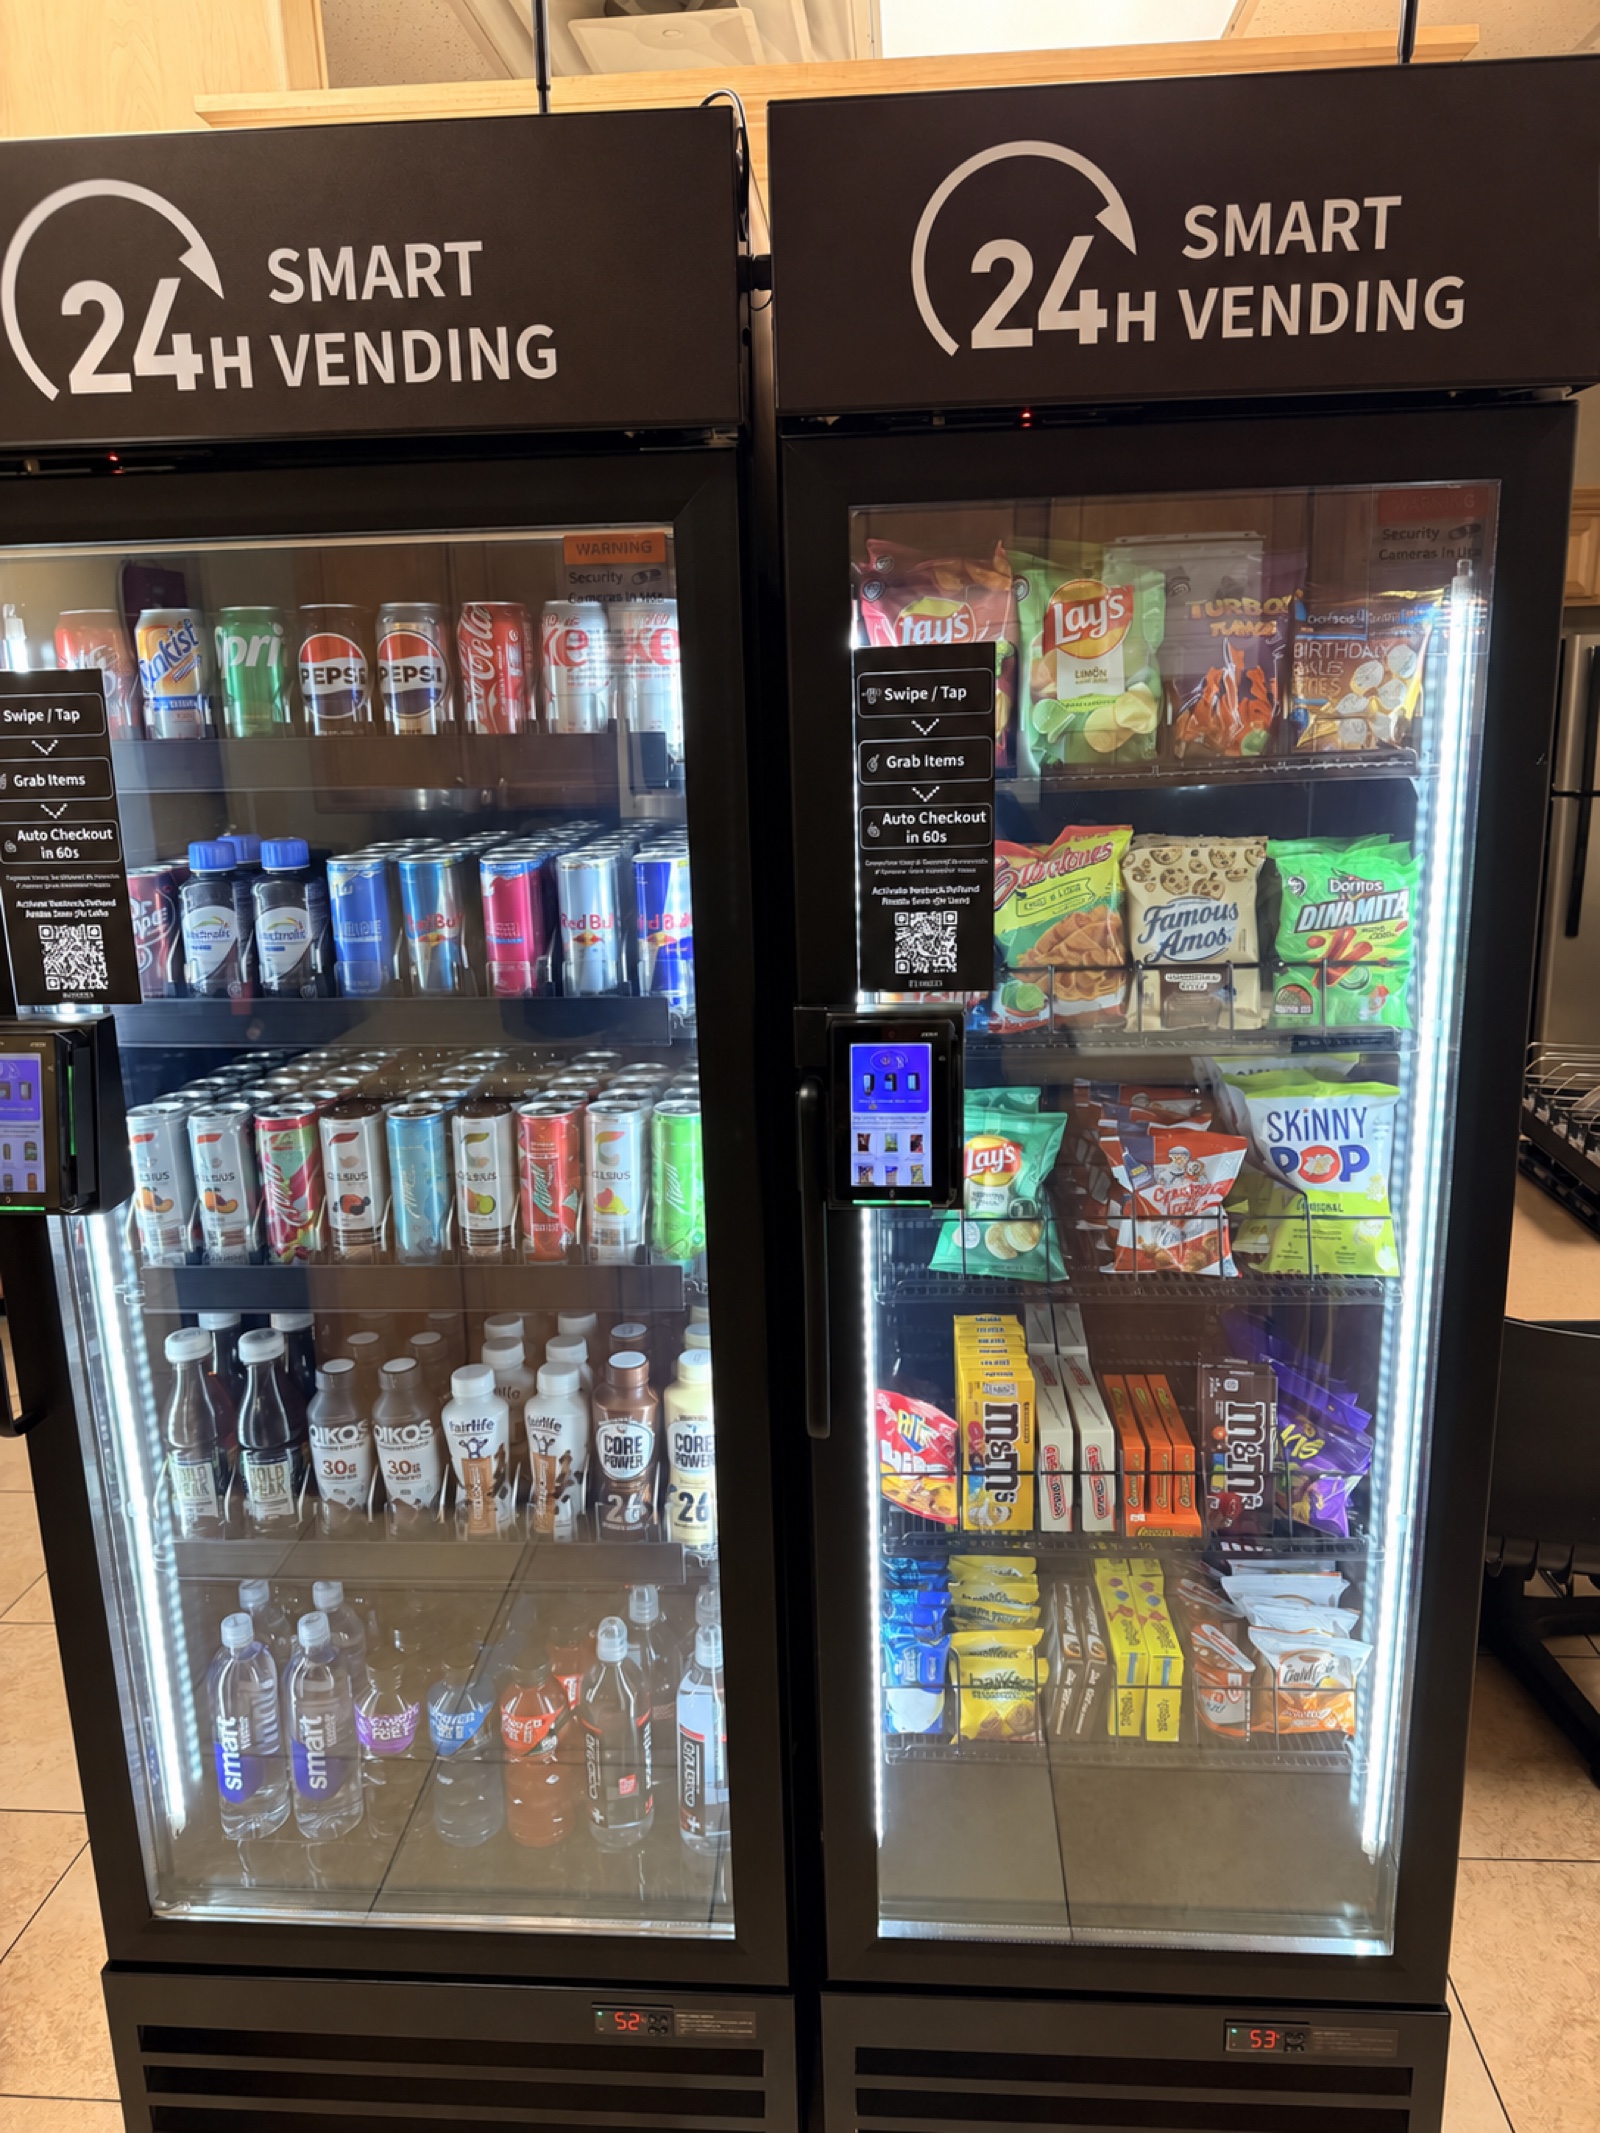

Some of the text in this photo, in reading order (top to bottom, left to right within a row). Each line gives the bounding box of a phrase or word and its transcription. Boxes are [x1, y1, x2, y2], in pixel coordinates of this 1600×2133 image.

[1182, 196, 1402, 260] SMART
[268, 241, 483, 303] SMART
[1179, 276, 1465, 340] VENDING
[270, 324, 558, 387] VENDING
[1383, 526, 1440, 542] Security
[575, 540, 653, 556] WARNING
[1379, 548, 1438, 561] Cameras
[568, 569, 623, 586] Security
[1053, 593, 1125, 646] Lay's
[301, 667, 368, 686] PEPSI
[379, 665, 443, 684] PEPSI
[884, 686, 929, 704] Swipe
[940, 686, 968, 701] Tap
[3, 708, 45, 725] Swipe
[54, 708, 81, 724] Tap
[886, 754, 965, 768] Grab Items
[13, 773, 86, 787] Grab Items
[882, 810, 987, 825] Auto Checkout
[17, 827, 114, 842] Auto Checkout
[906, 830, 948, 844] in 60s
[40, 846, 80, 859] in 60s
[1328, 879, 1384, 893] Doritos
[1296, 887, 1410, 932] DINAMITA
[1137, 900, 1239, 945] Famous
[966, 1142, 1017, 1176] Lay's
[1269, 1144, 1371, 1184] POP
[373, 1418, 433, 1445] OIKOS
[448, 1417, 495, 1434] fairlife
[603, 1434, 643, 1453] CORE
[675, 1432, 714, 1453] CORE
[603, 1453, 644, 1468] POWER
[217, 1715, 242, 1791] smart
[299, 1715, 328, 1790] smart
[614, 2011, 641, 2031] 52
[1250, 2029, 1277, 2049] 53
